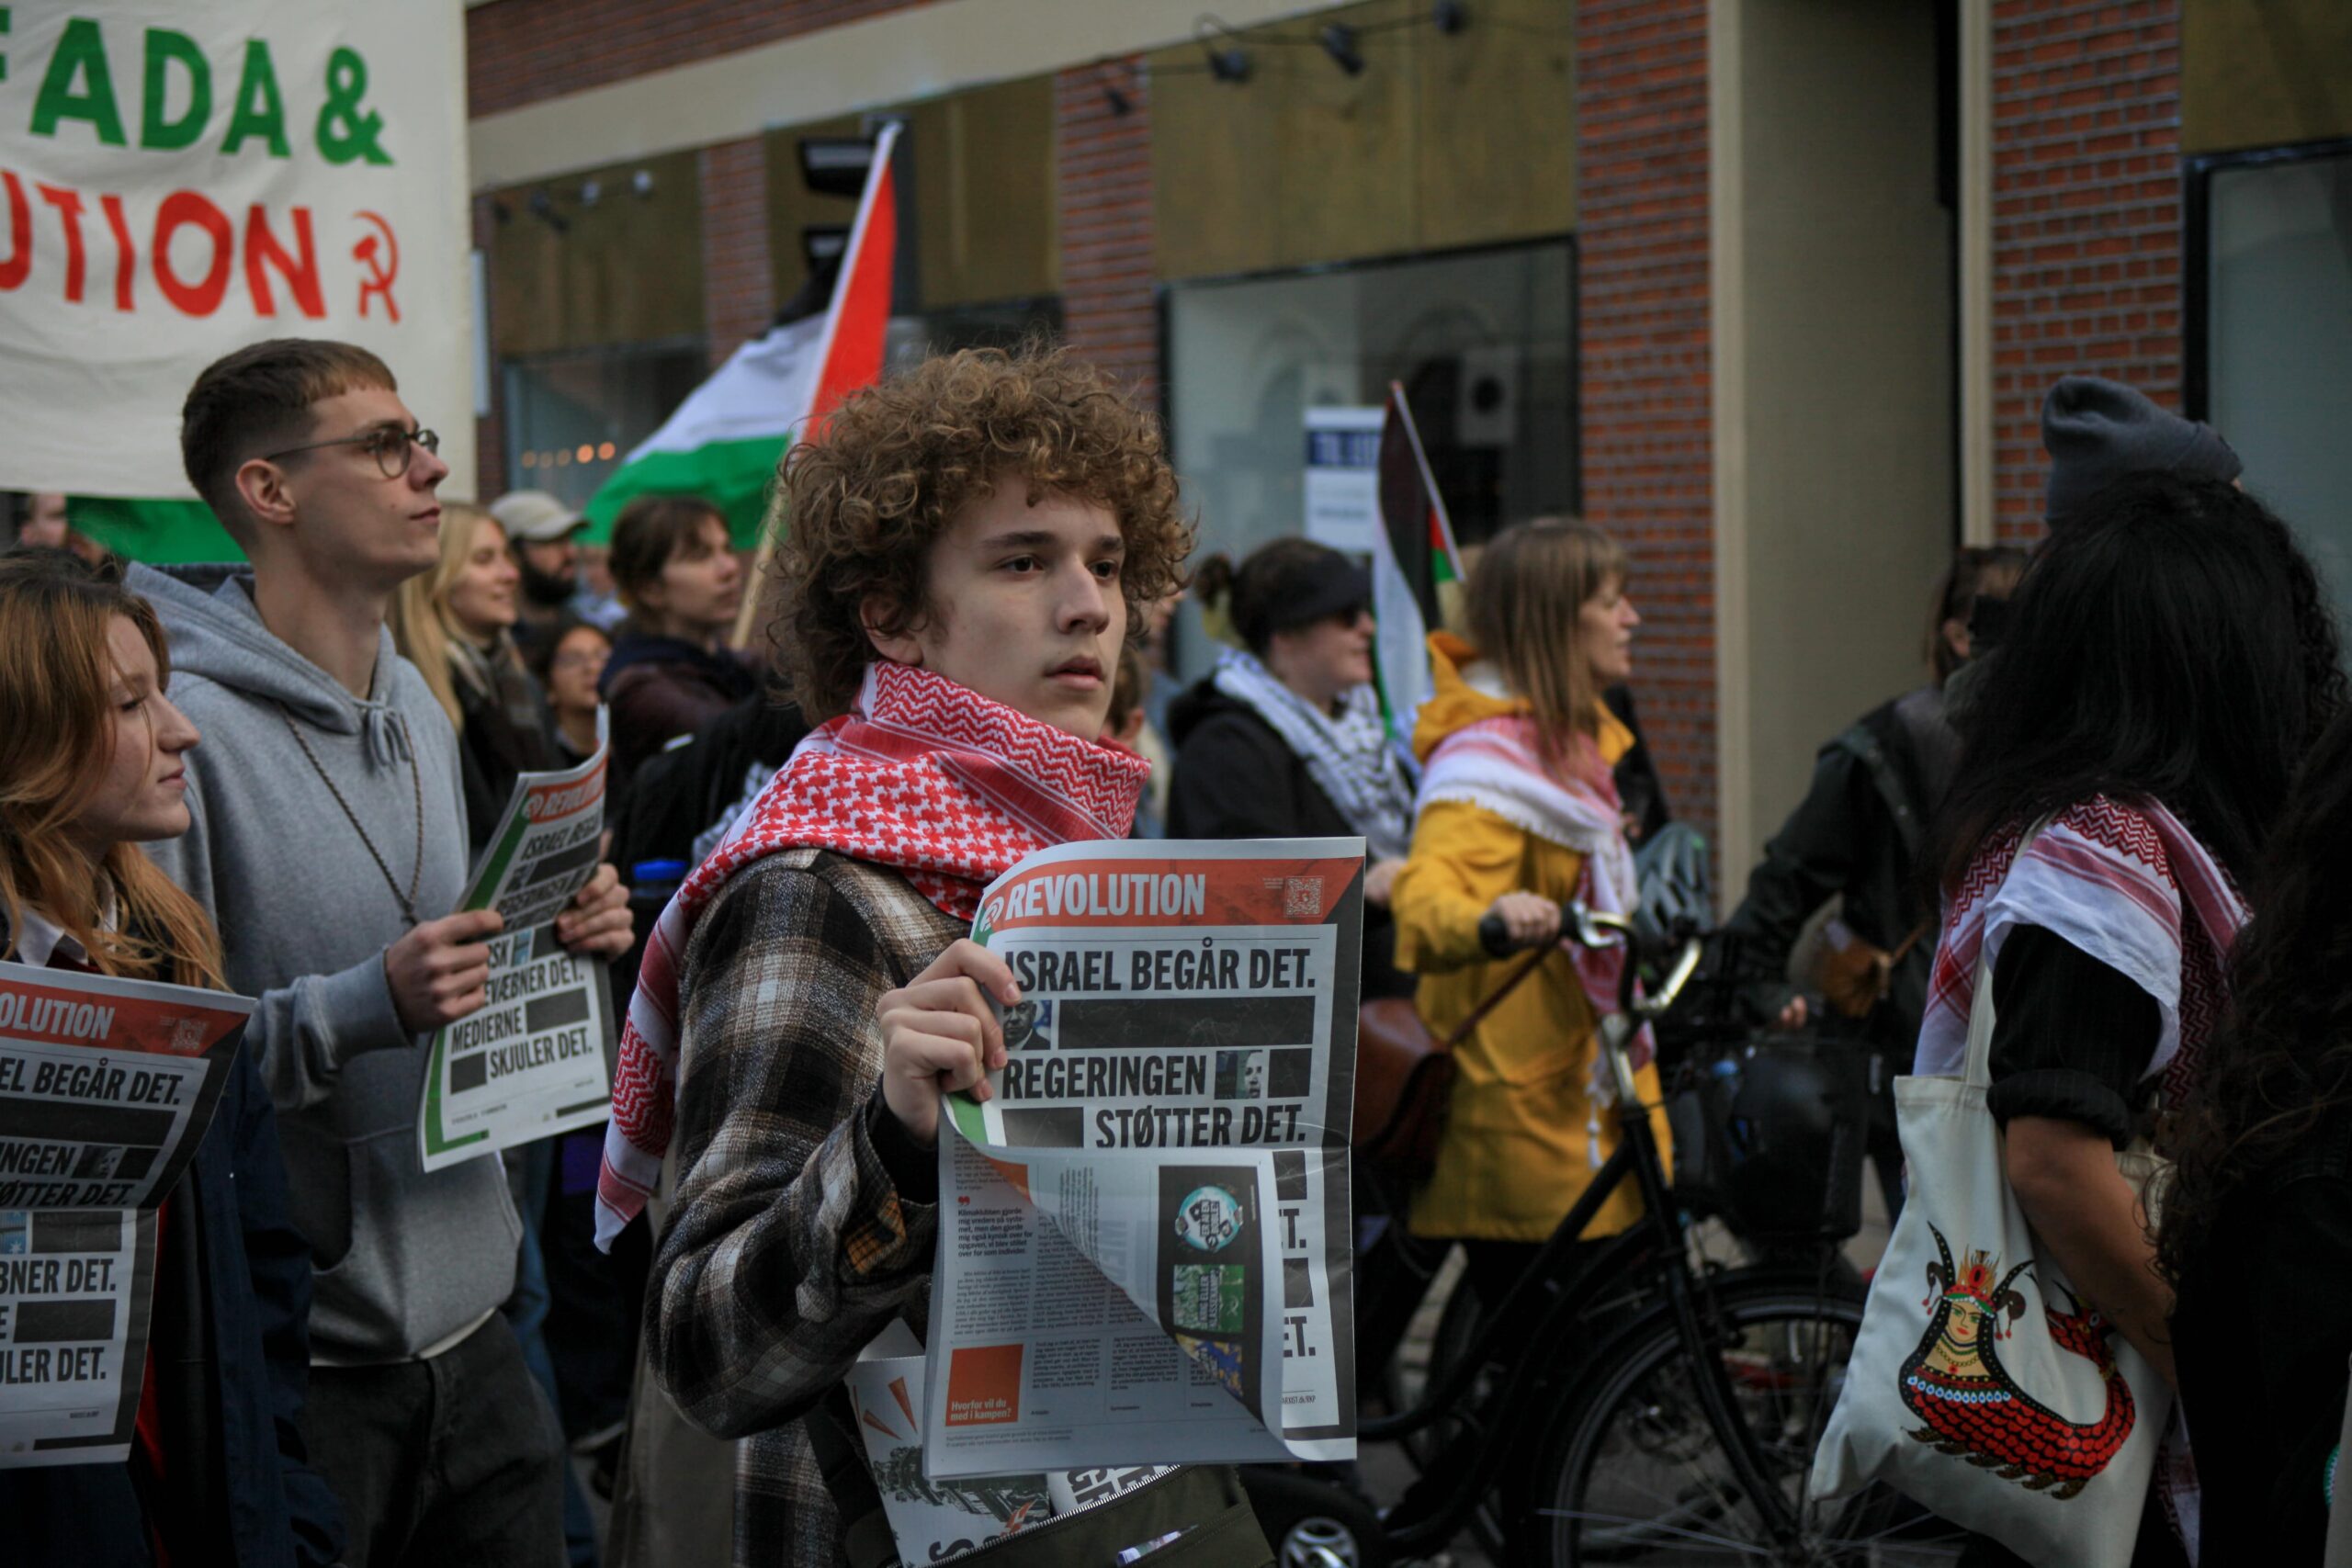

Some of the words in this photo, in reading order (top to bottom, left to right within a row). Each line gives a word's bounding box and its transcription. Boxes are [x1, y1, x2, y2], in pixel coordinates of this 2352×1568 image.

[316, 45, 395, 166] &
[1005, 874, 1205, 919] REVOLUTION
[549, 957, 584, 987] DET.
[1007, 949, 1125, 991] ISRAEL
[1131, 937, 1242, 991] BEGÅR
[1250, 948, 1316, 989] DET.
[451, 1005, 523, 1055] MEDIERNE
[490, 1035, 556, 1079] SKJULER
[558, 1027, 593, 1059] DET.
[32, 1057, 126, 1101] BEGÅR
[128, 1071, 184, 1105] DET.
[1002, 1055, 1206, 1100] REGERINGEN
[1096, 1104, 1235, 1147] STØTTER
[1238, 1103, 1306, 1145] DET.
[75, 1182, 135, 1206] DET.
[66, 1258, 116, 1292] DET.
[57, 1347, 107, 1382] DET.
[951, 1411, 967, 1420] med
[974, 1408, 1012, 1420] kampen?
[952, 1400, 982, 1411] Hvorfor
[984, 1399, 994, 1408] vil
[996, 1398, 1006, 1407] du
